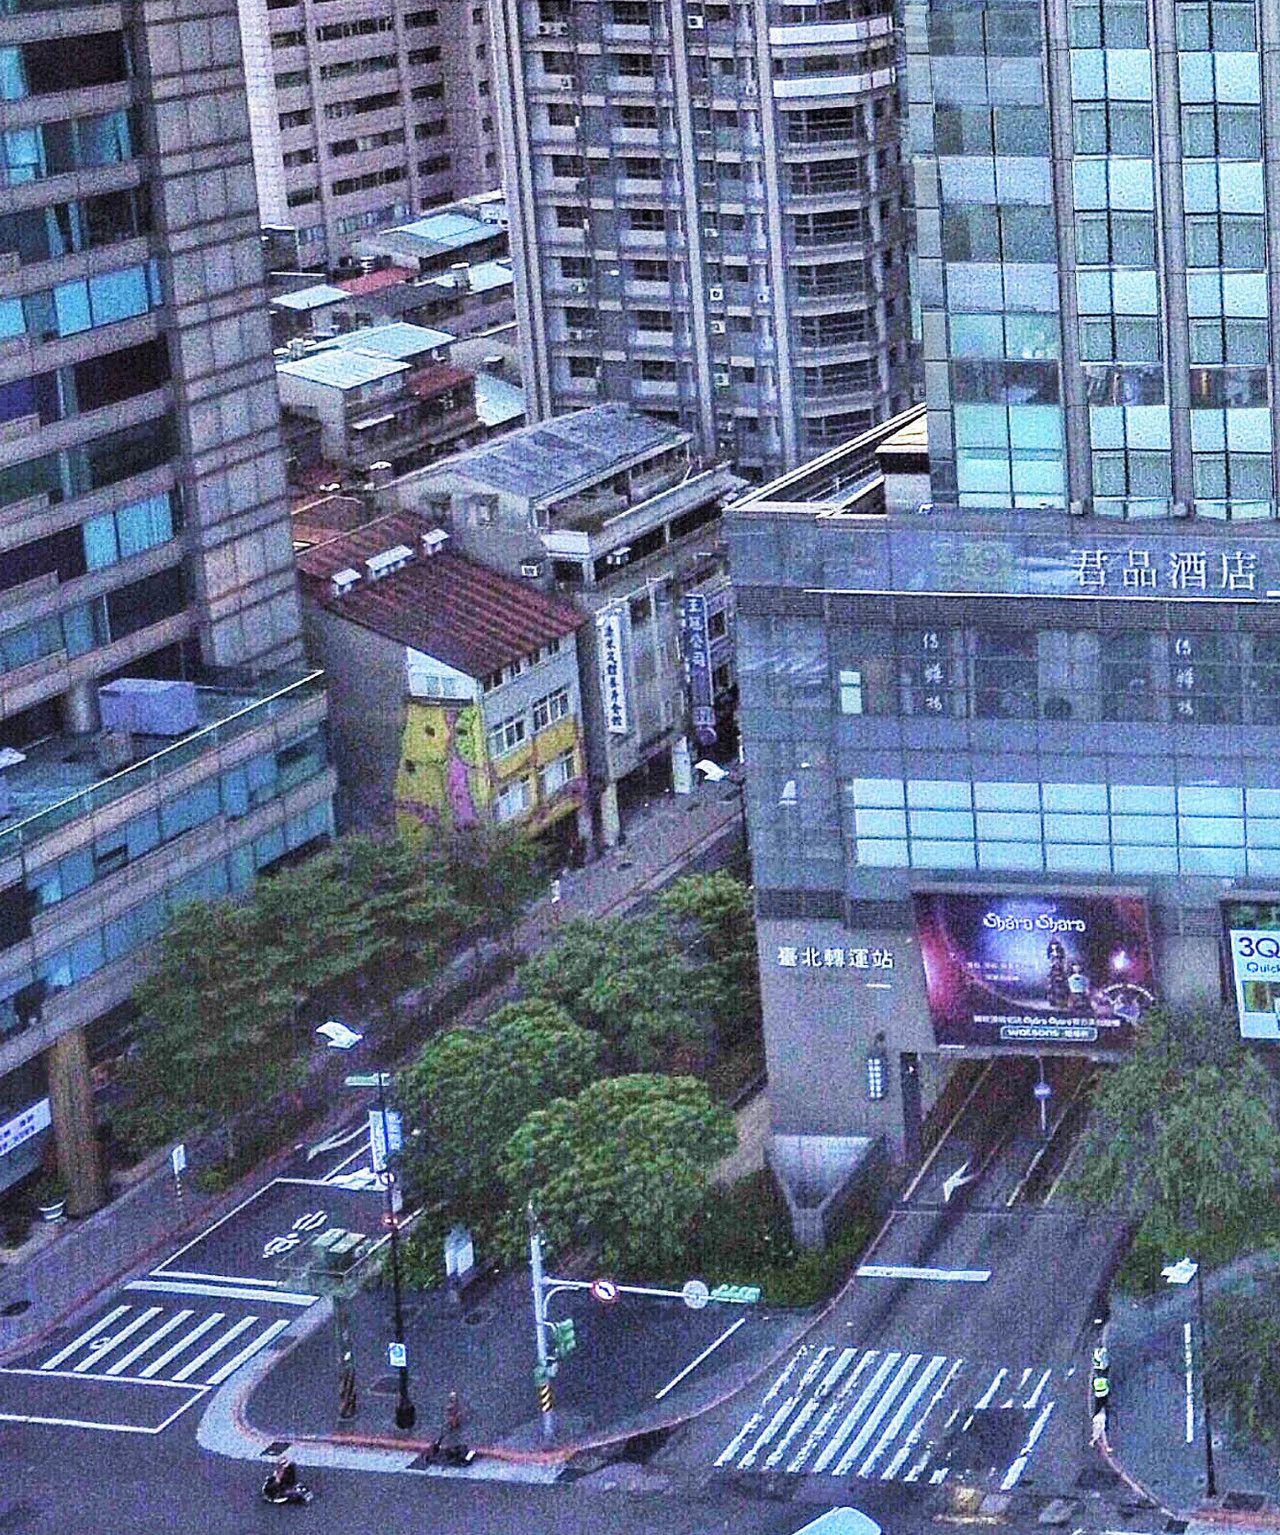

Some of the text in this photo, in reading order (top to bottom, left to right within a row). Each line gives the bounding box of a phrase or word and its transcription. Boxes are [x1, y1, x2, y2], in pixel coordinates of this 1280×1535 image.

[1071, 549, 1258, 591] 君品酒店
[778, 946, 895, 969] 臺北轉運站
